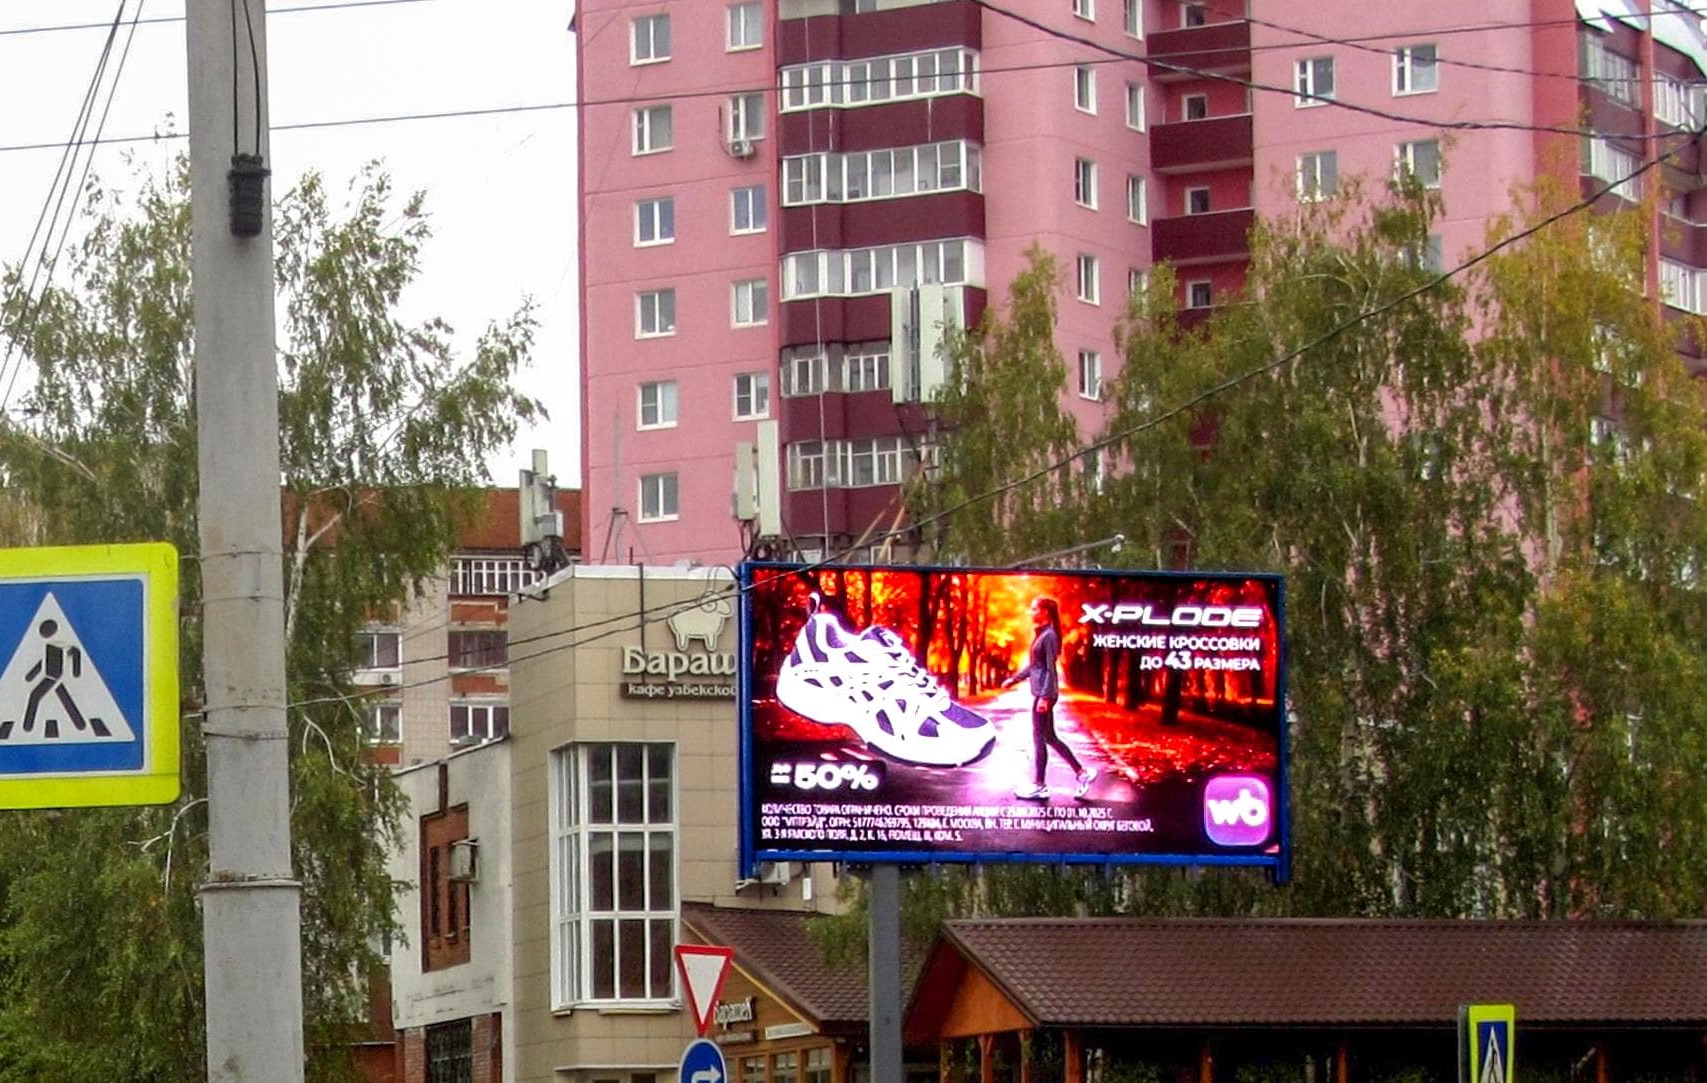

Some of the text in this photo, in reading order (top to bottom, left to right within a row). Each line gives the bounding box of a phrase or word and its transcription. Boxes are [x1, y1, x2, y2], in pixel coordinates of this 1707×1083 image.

[1093, 634, 1260, 651] ЖЕНСКИЕ КРОССОВКИ
[1139, 651, 1260, 671] ДО 43 РАЗМЕРА
[628, 683, 665, 698] кафе
[1207, 788, 1267, 828] wb
